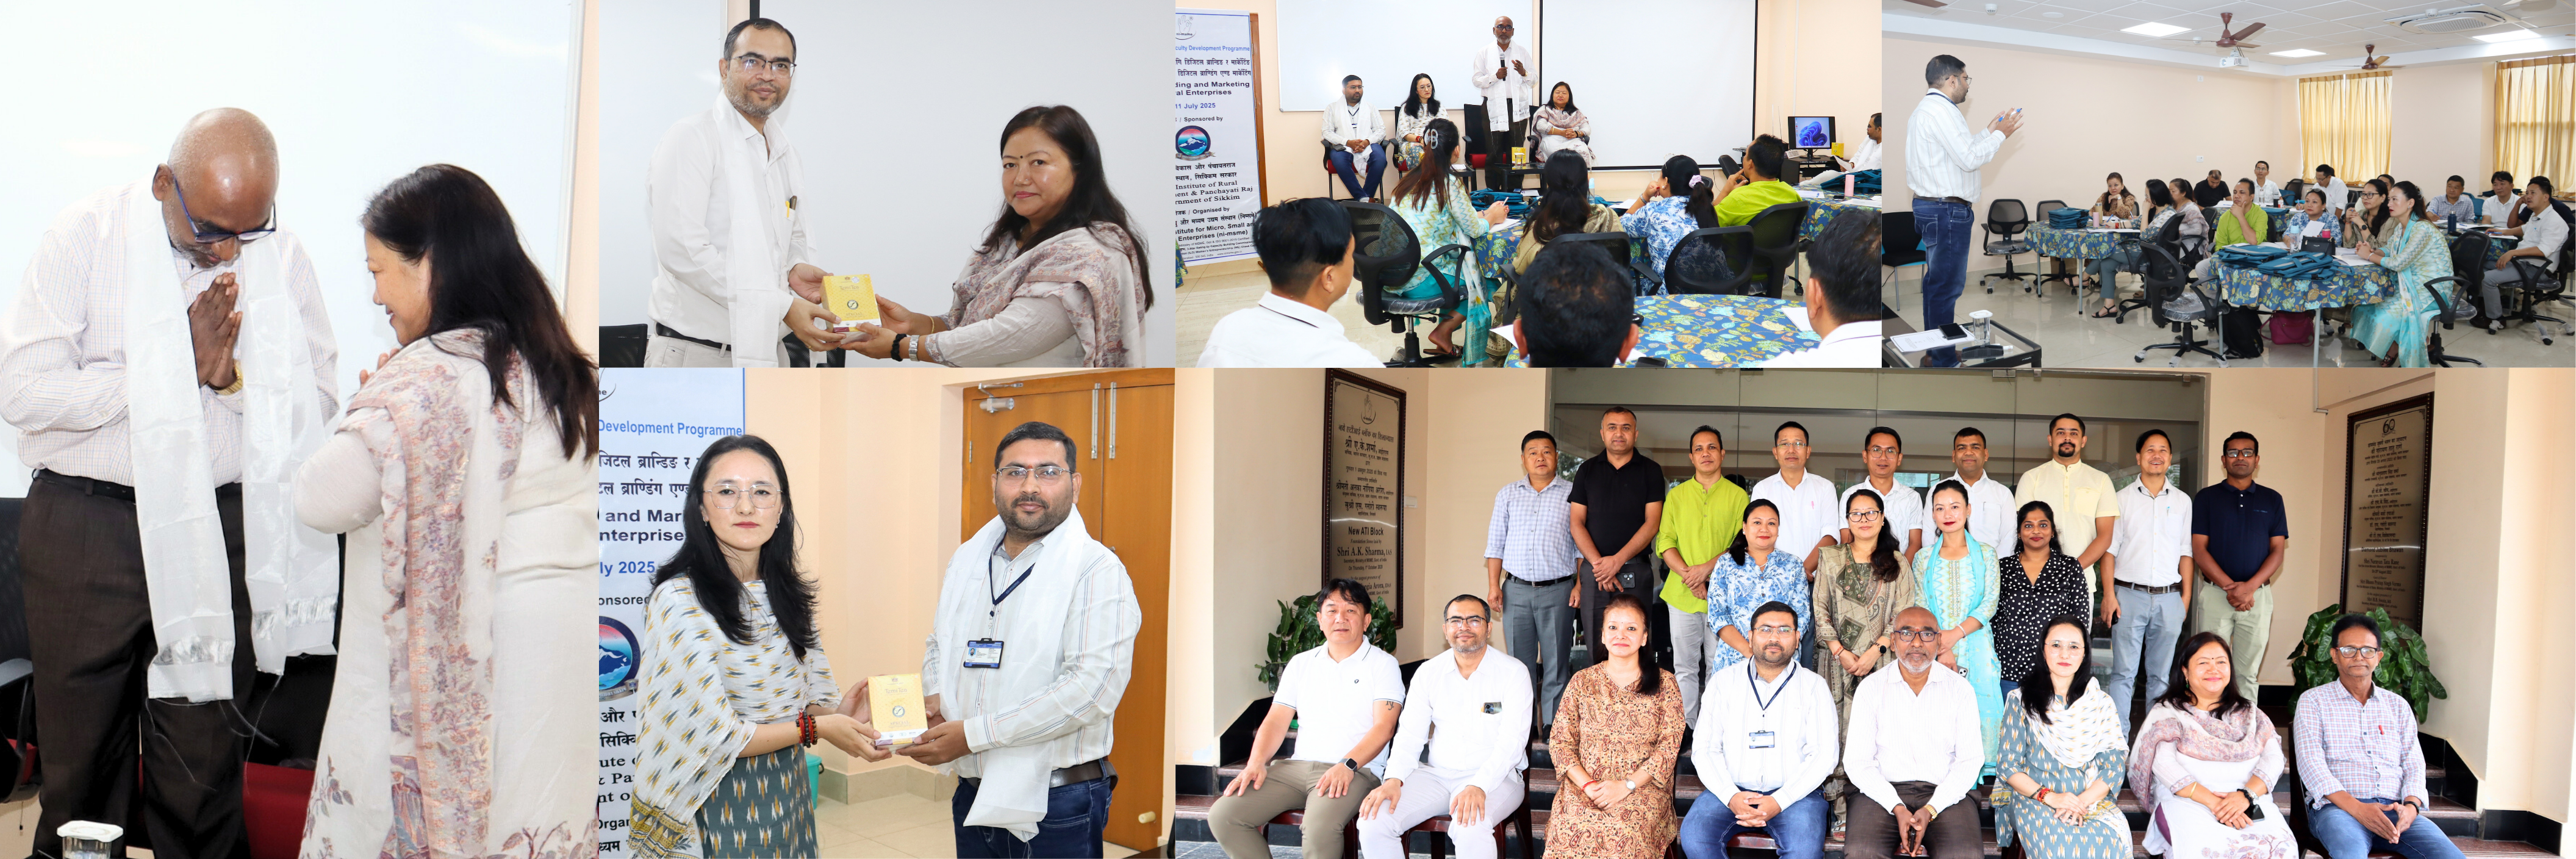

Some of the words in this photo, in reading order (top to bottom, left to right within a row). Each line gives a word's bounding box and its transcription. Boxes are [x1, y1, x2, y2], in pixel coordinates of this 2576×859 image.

[1193, 207, 1222, 215] Organised
[1178, 233, 1215, 242] Enterprises
[1216, 229, 1248, 238] (ni-msme)
[599, 419, 674, 436] Development
[677, 422, 743, 438] Programme
[2383, 419, 2395, 434] 60
[620, 478, 662, 495] ब्राण्डिंग
[605, 509, 640, 522] and
[648, 510, 682, 522] Mar
[599, 529, 684, 544] nterprise
[1348, 526, 1360, 536] New
[1361, 527, 1369, 535] ATI
[1370, 527, 1384, 536] Block
[1337, 547, 1349, 556] Shri
[1351, 546, 1364, 556] A.K.
[1365, 547, 1385, 557] Sharma,
[619, 561, 656, 574] 2025
[600, 707, 625, 723] और
